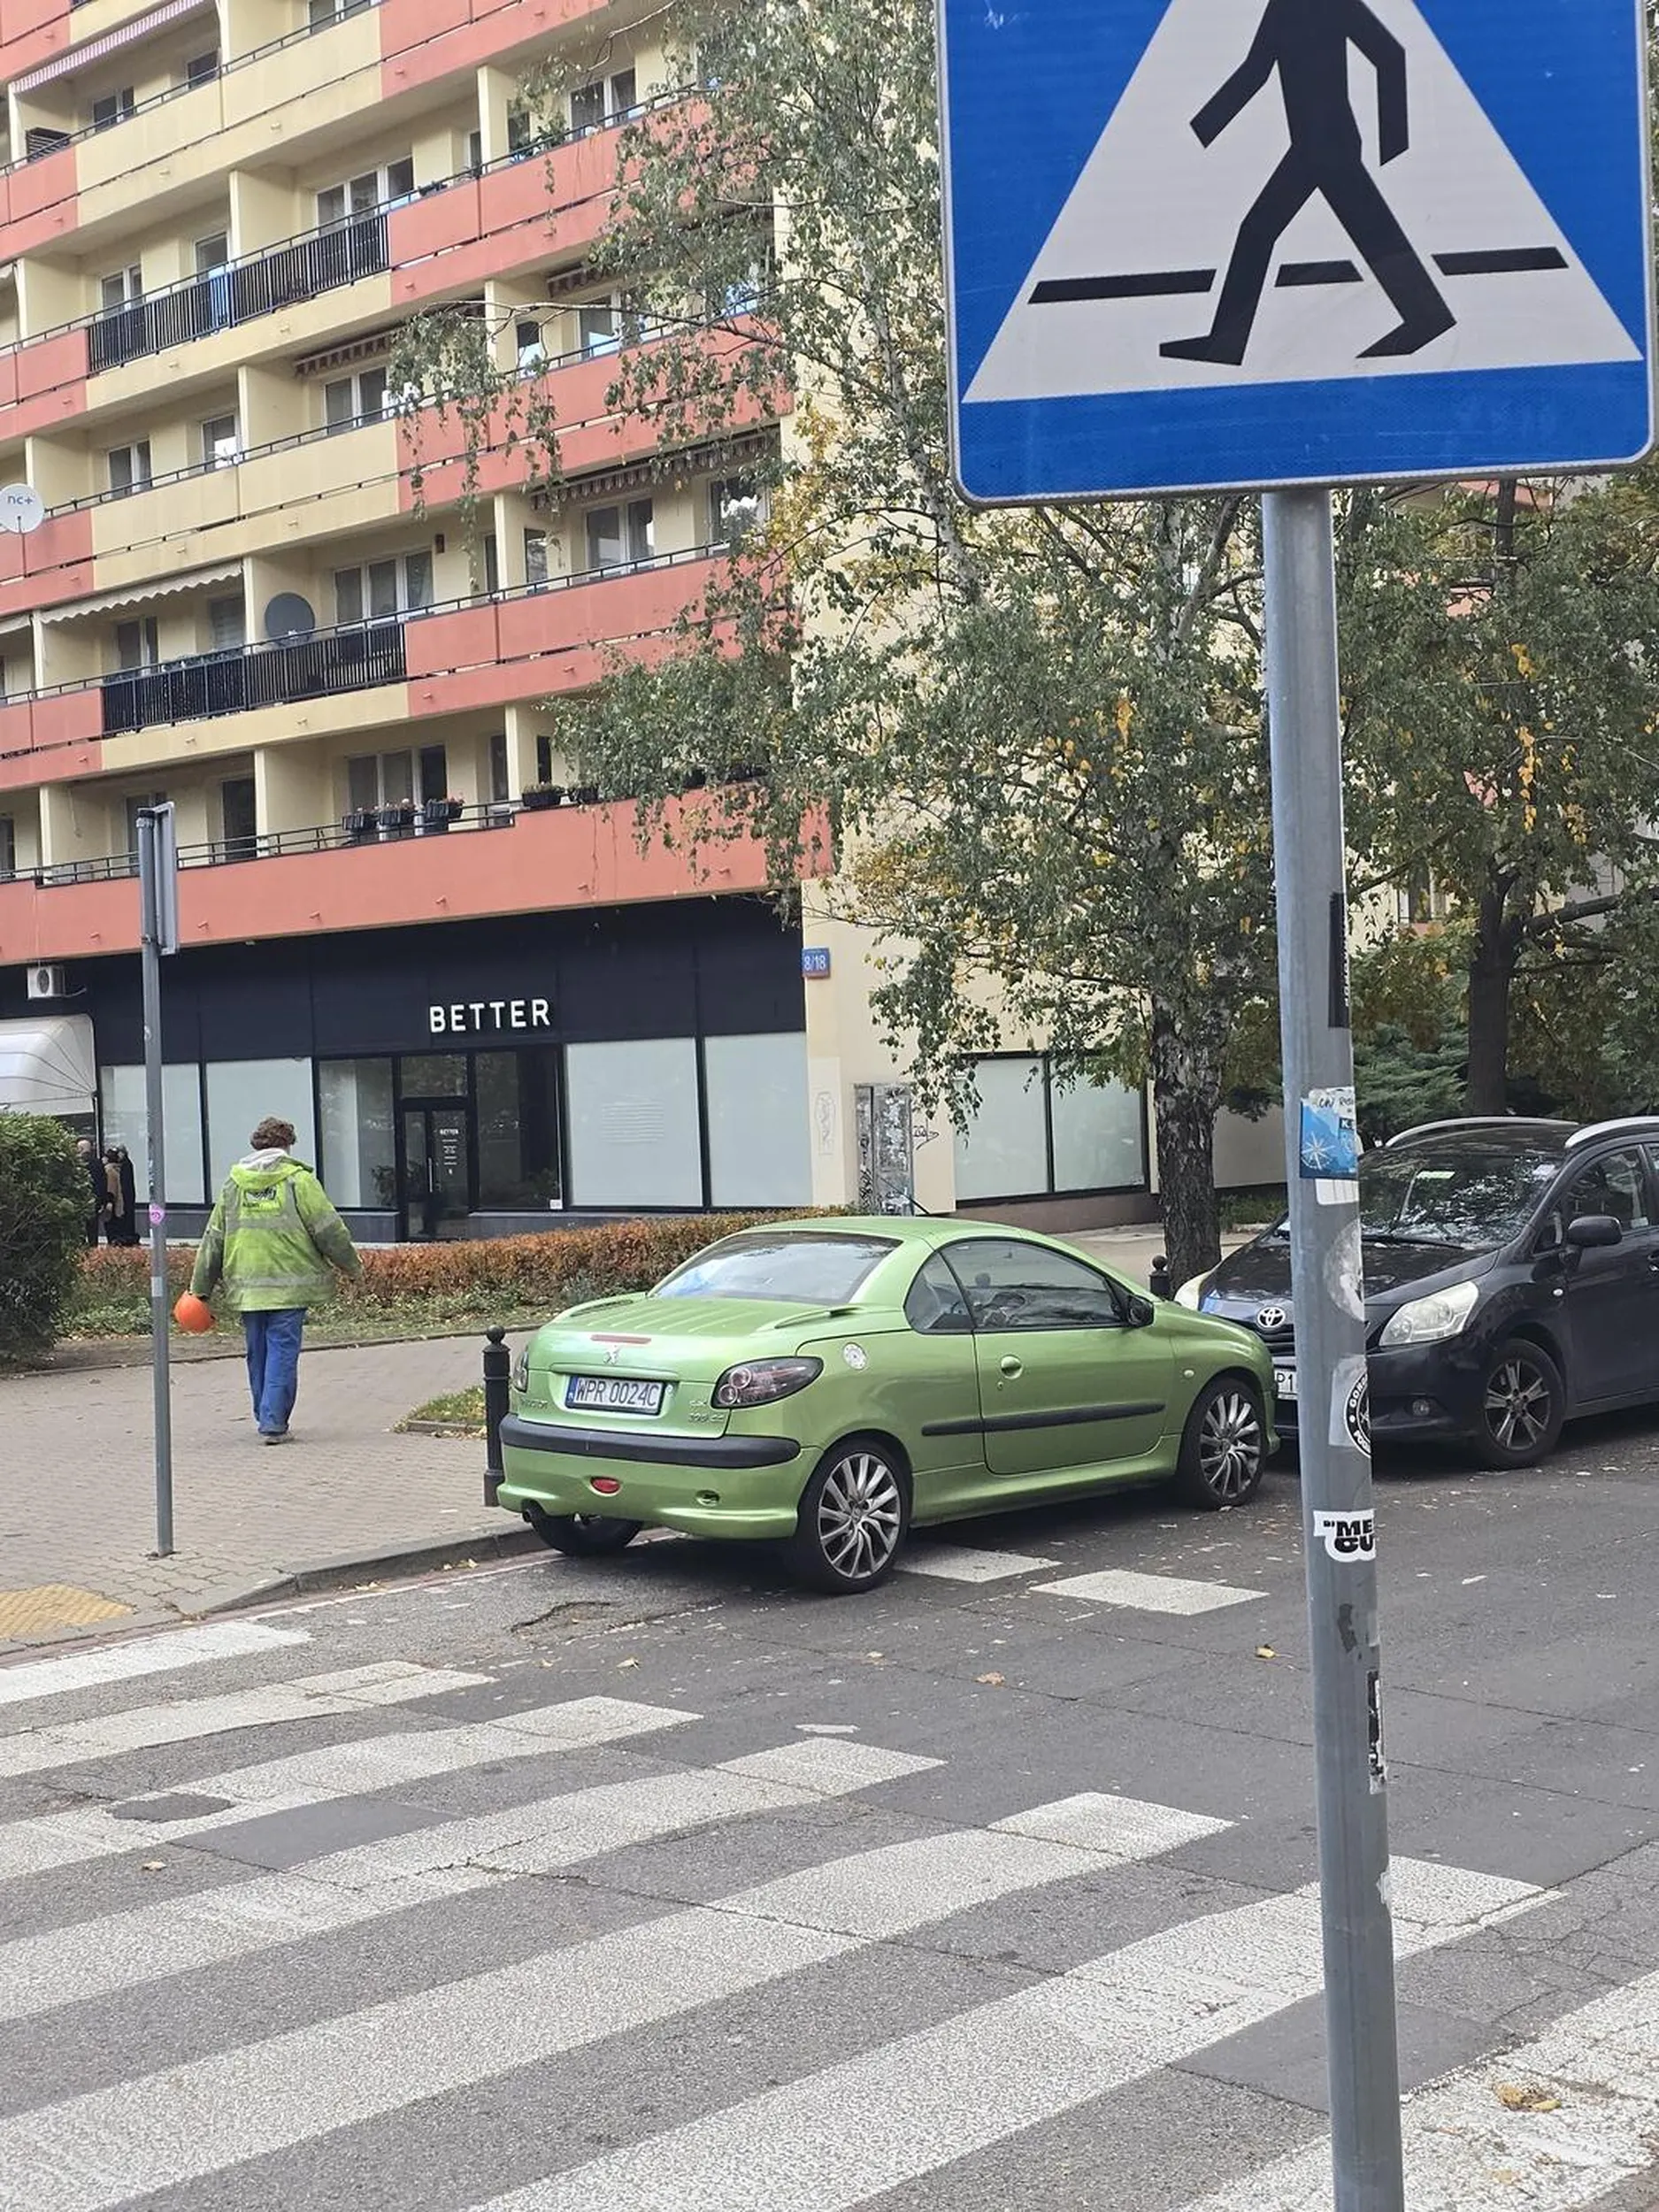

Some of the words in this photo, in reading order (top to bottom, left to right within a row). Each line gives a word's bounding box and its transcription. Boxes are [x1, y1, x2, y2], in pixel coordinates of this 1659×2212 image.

[7, 495, 33, 504] nc+
[429, 999, 550, 1033] BETTER
[576, 1378, 606, 1402] WPR
[610, 1382, 659, 1406] 0024C
